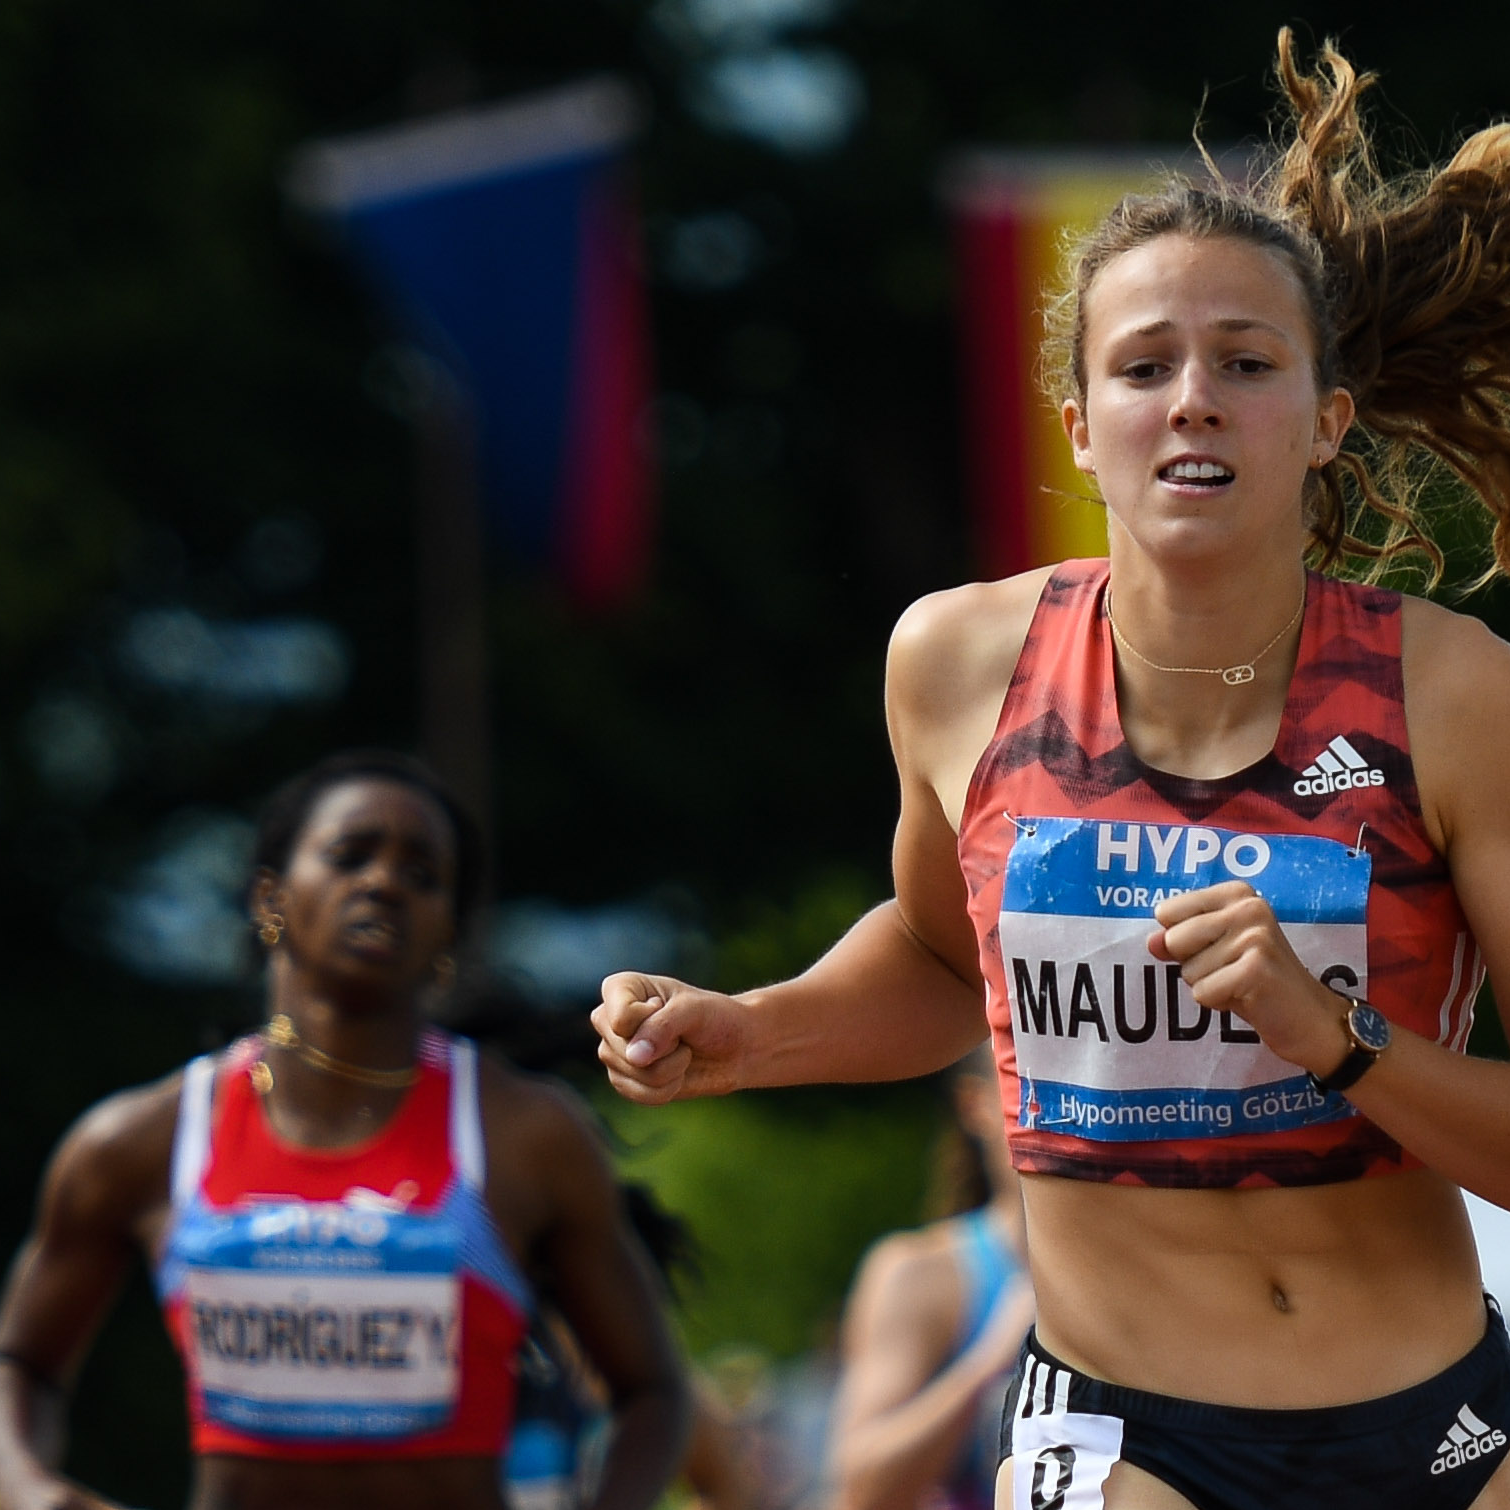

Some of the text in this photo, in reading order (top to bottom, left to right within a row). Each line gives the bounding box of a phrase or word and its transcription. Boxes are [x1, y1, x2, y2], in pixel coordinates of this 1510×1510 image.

[1293, 768, 1385, 796] adidas
[1096, 823, 1271, 878] HYPO
[1060, 1084, 1326, 1128] Hypomeeting Götzis
[1430, 1429, 1507, 1475] adidas
